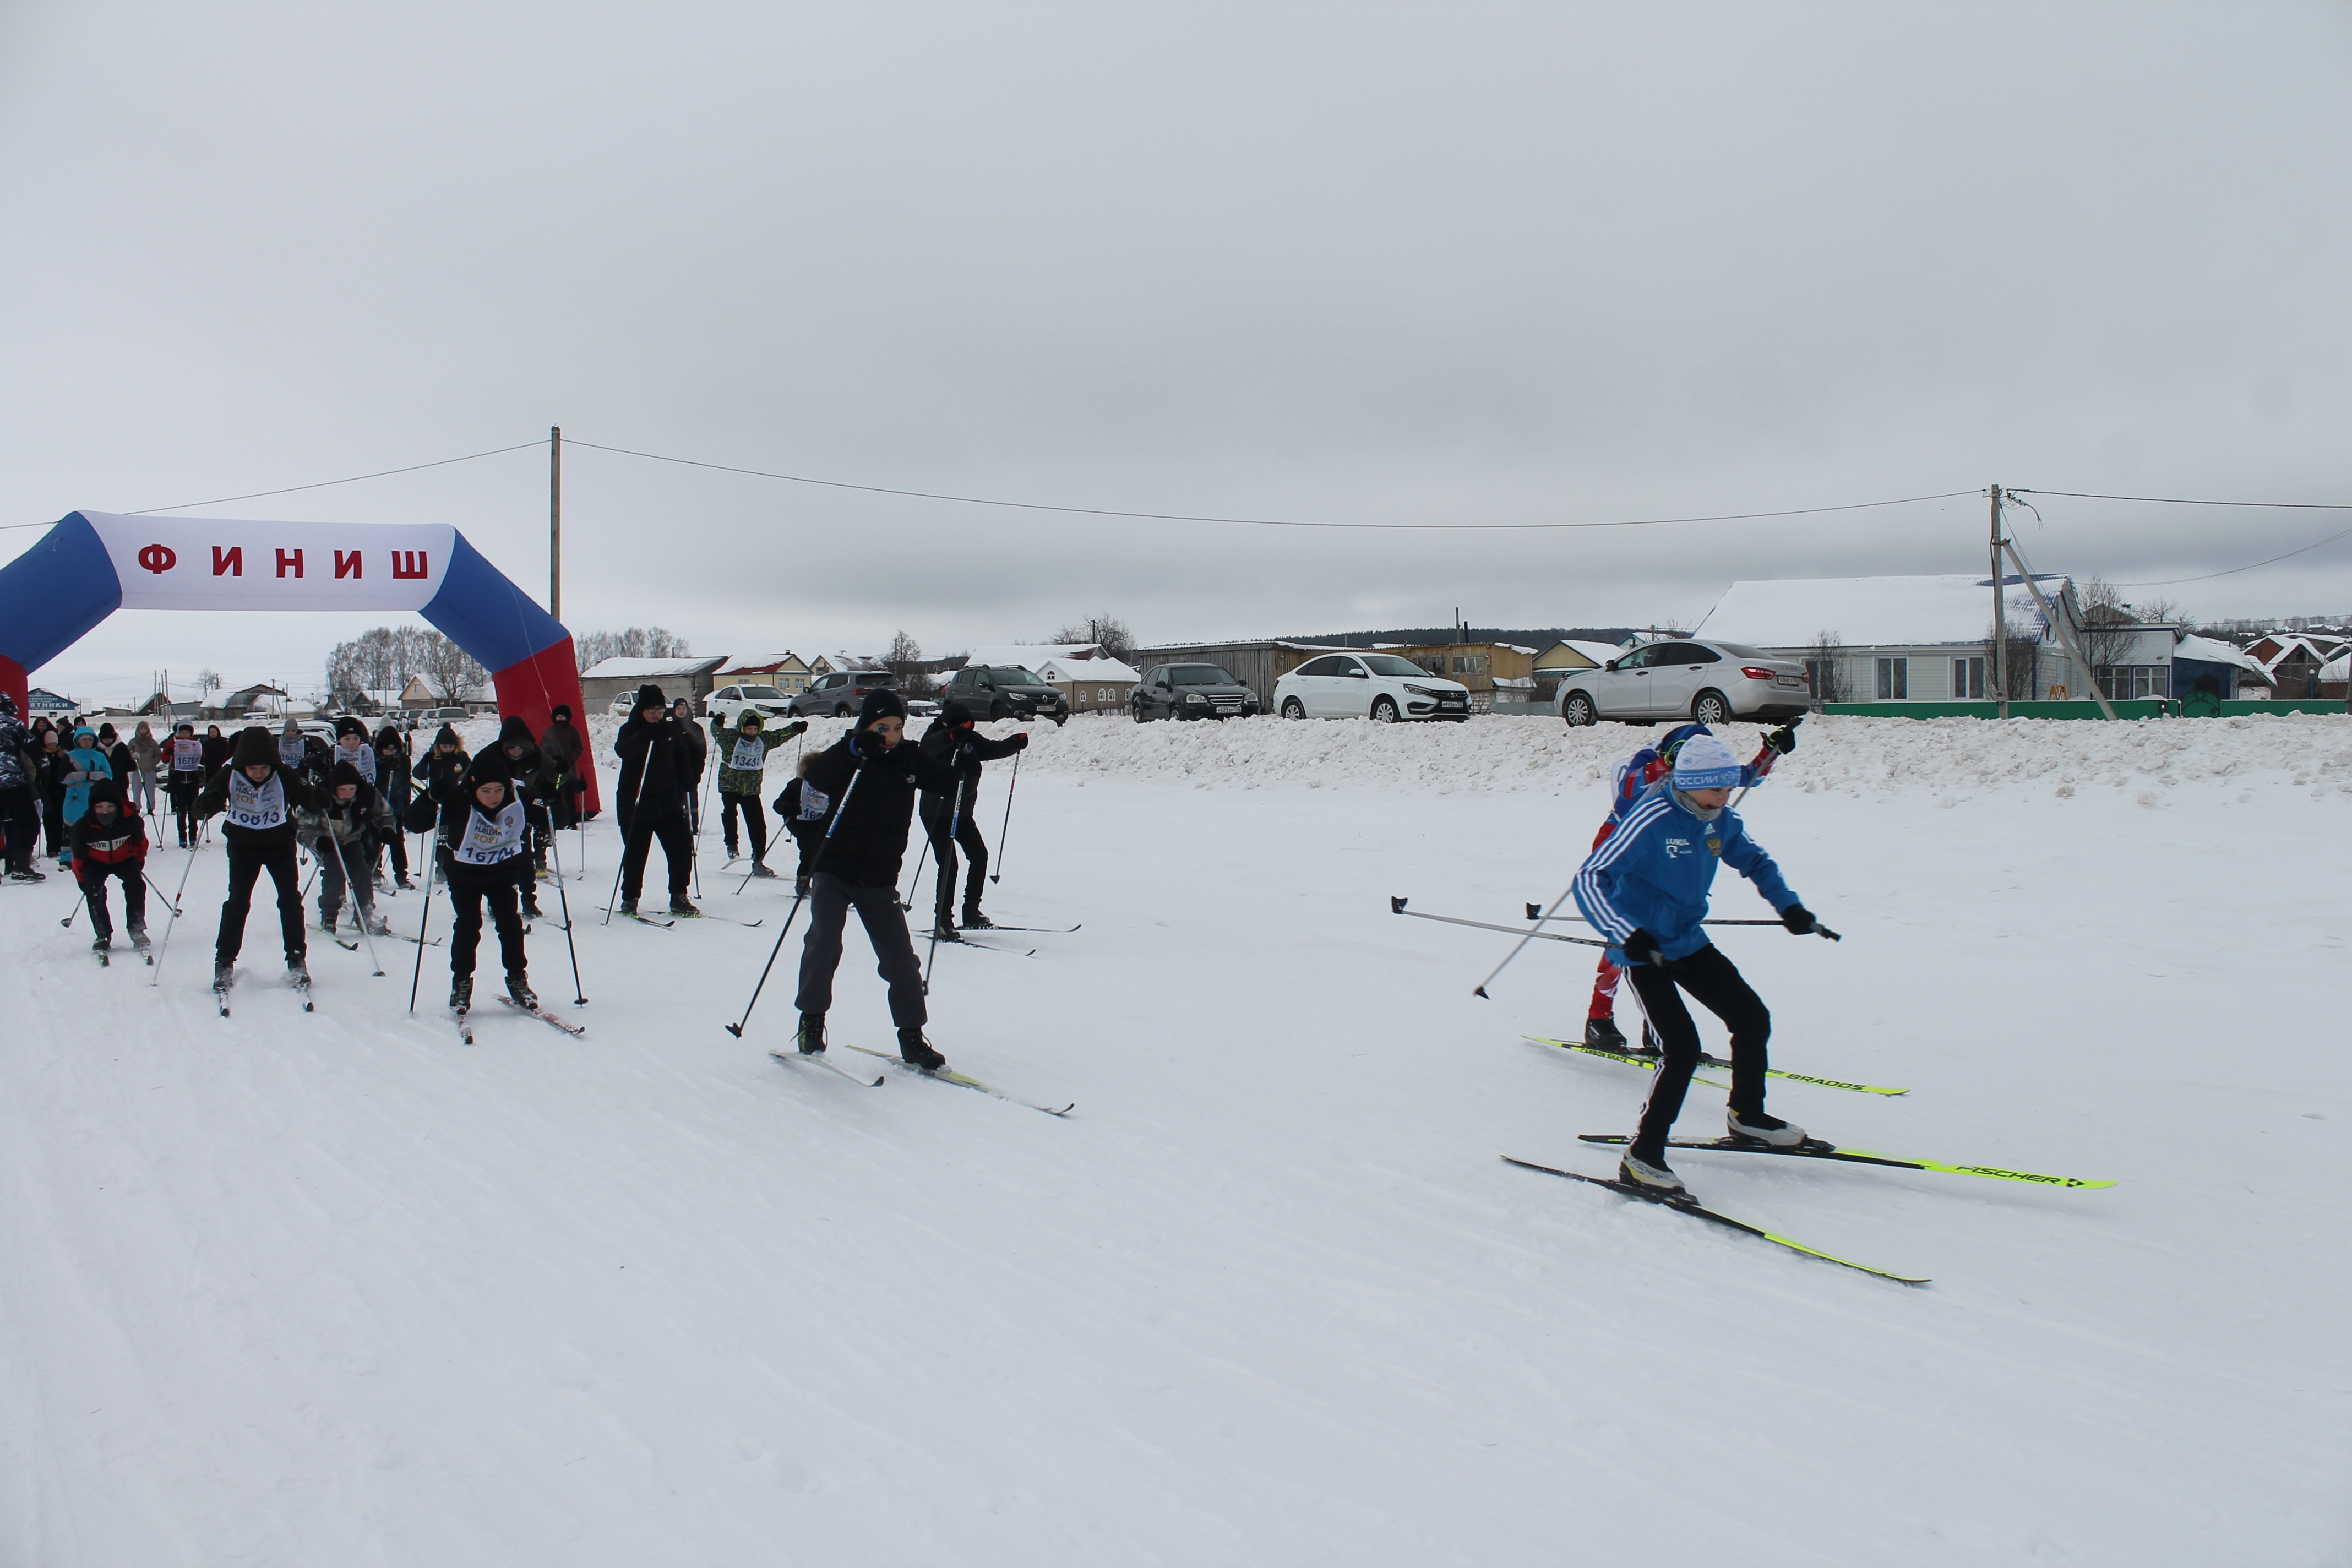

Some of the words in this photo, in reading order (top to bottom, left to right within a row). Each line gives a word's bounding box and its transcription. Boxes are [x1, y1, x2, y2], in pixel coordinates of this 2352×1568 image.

[138, 543, 428, 579] ФИНИШ
[1785, 1074, 1866, 1091] BRADOS
[1955, 1166, 2061, 1184] FISCHER
